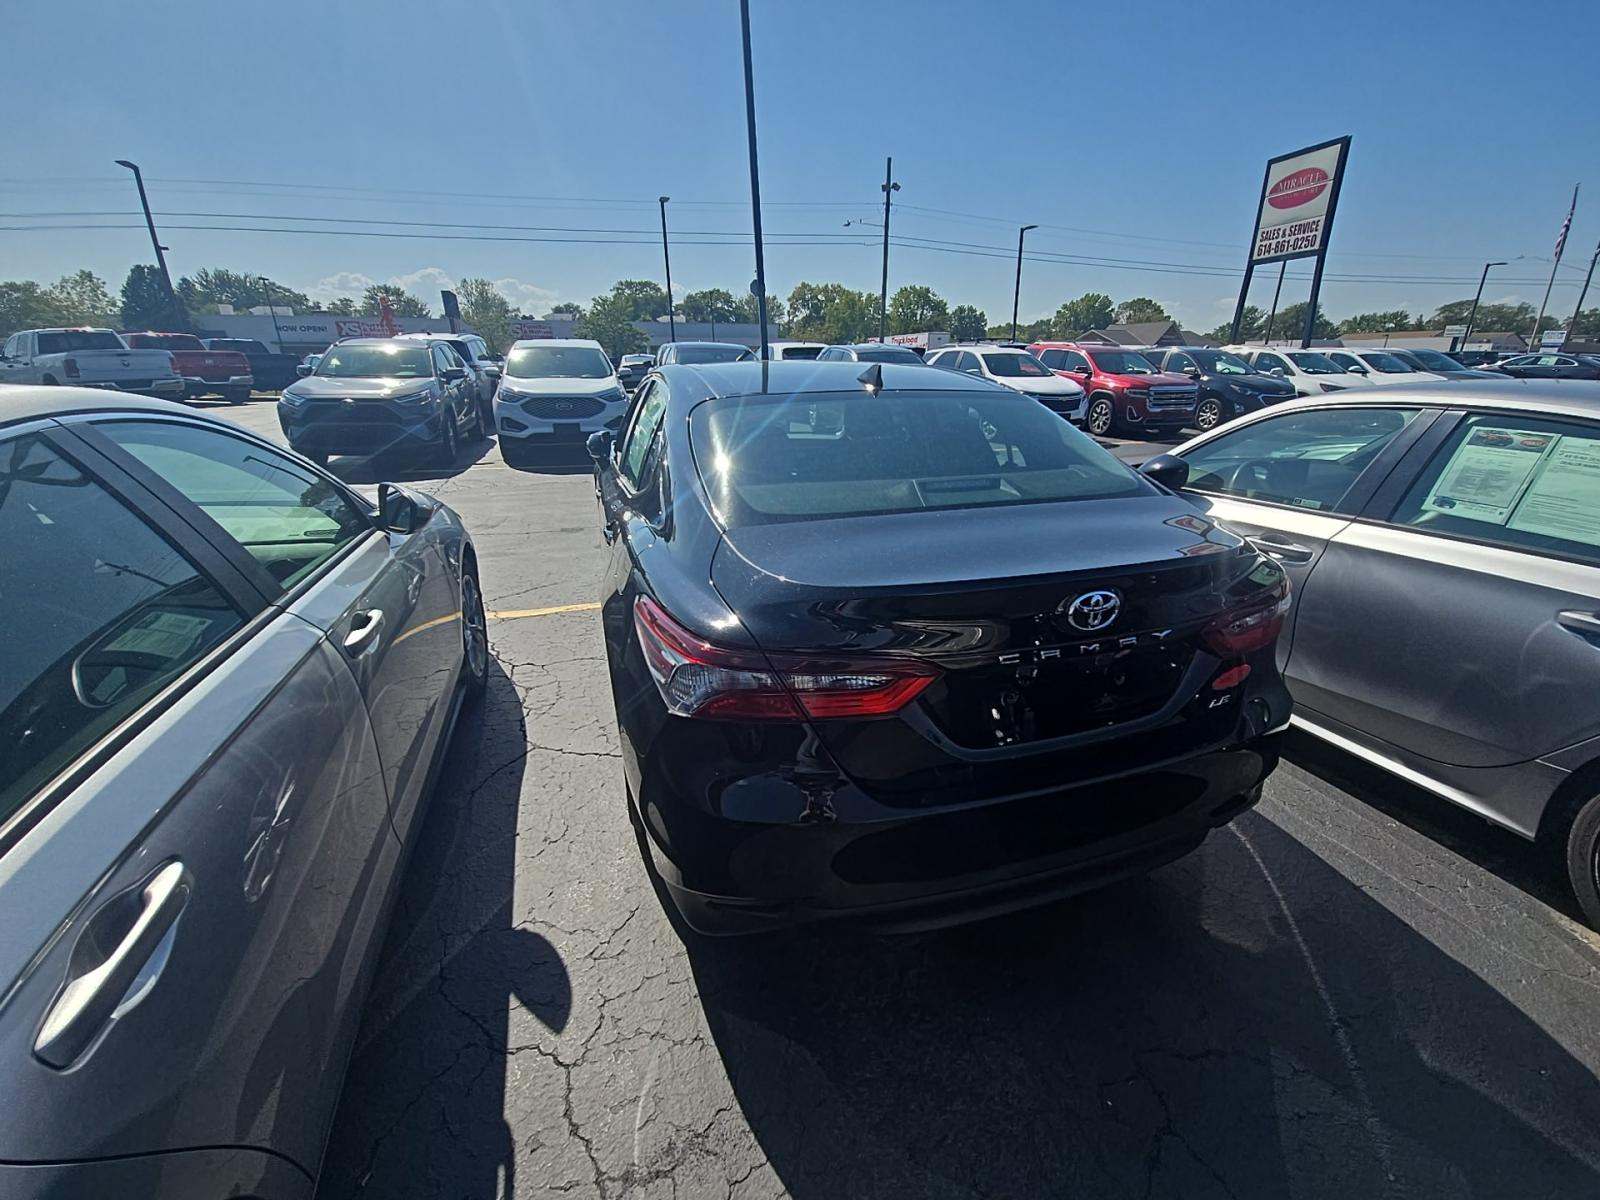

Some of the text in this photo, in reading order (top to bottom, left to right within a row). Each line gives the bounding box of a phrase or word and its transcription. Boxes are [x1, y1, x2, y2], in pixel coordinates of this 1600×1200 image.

[1259, 220, 1320, 242] SALES & SERVICE
[1257, 234, 1316, 256] 614-861-0250
[998, 629, 1173, 665] CAMRY
